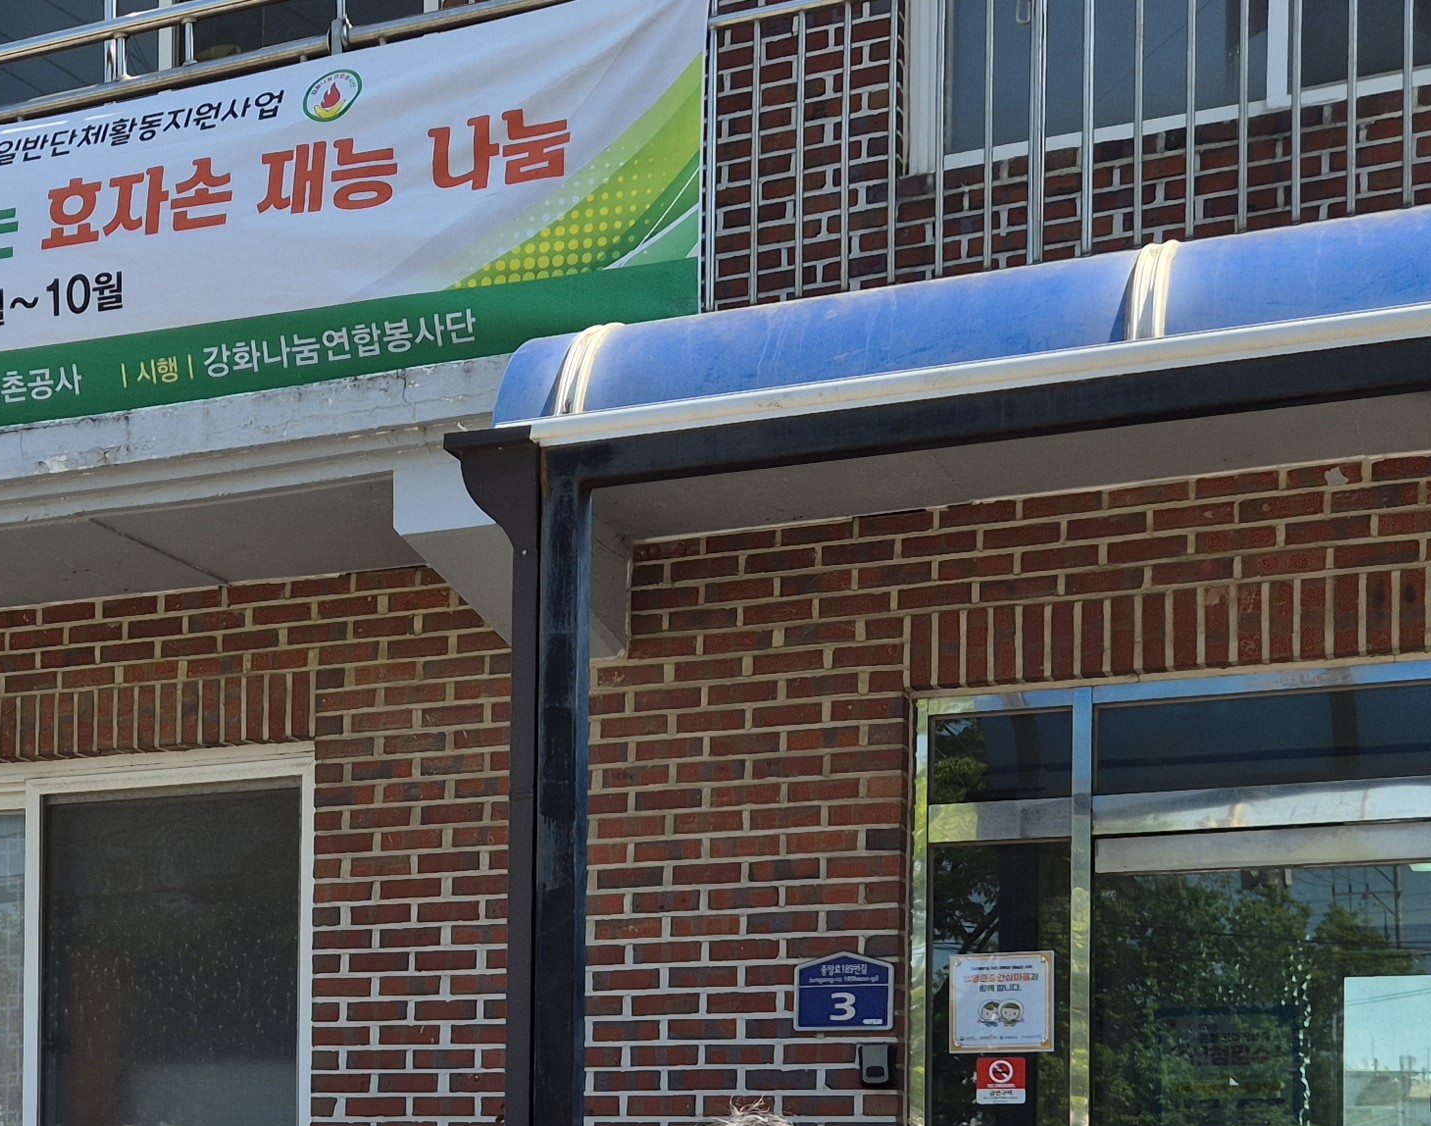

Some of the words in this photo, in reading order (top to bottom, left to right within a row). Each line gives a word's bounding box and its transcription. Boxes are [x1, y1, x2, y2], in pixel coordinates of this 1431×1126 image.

[41, 157, 233, 250] 효자손
[256, 137, 398, 215] 재능
[428, 109, 570, 191] 나눔
[136, 357, 178, 386] 시행
[202, 308, 476, 378] 강화나눔연합봉사단
[829, 992, 856, 1021] 3
